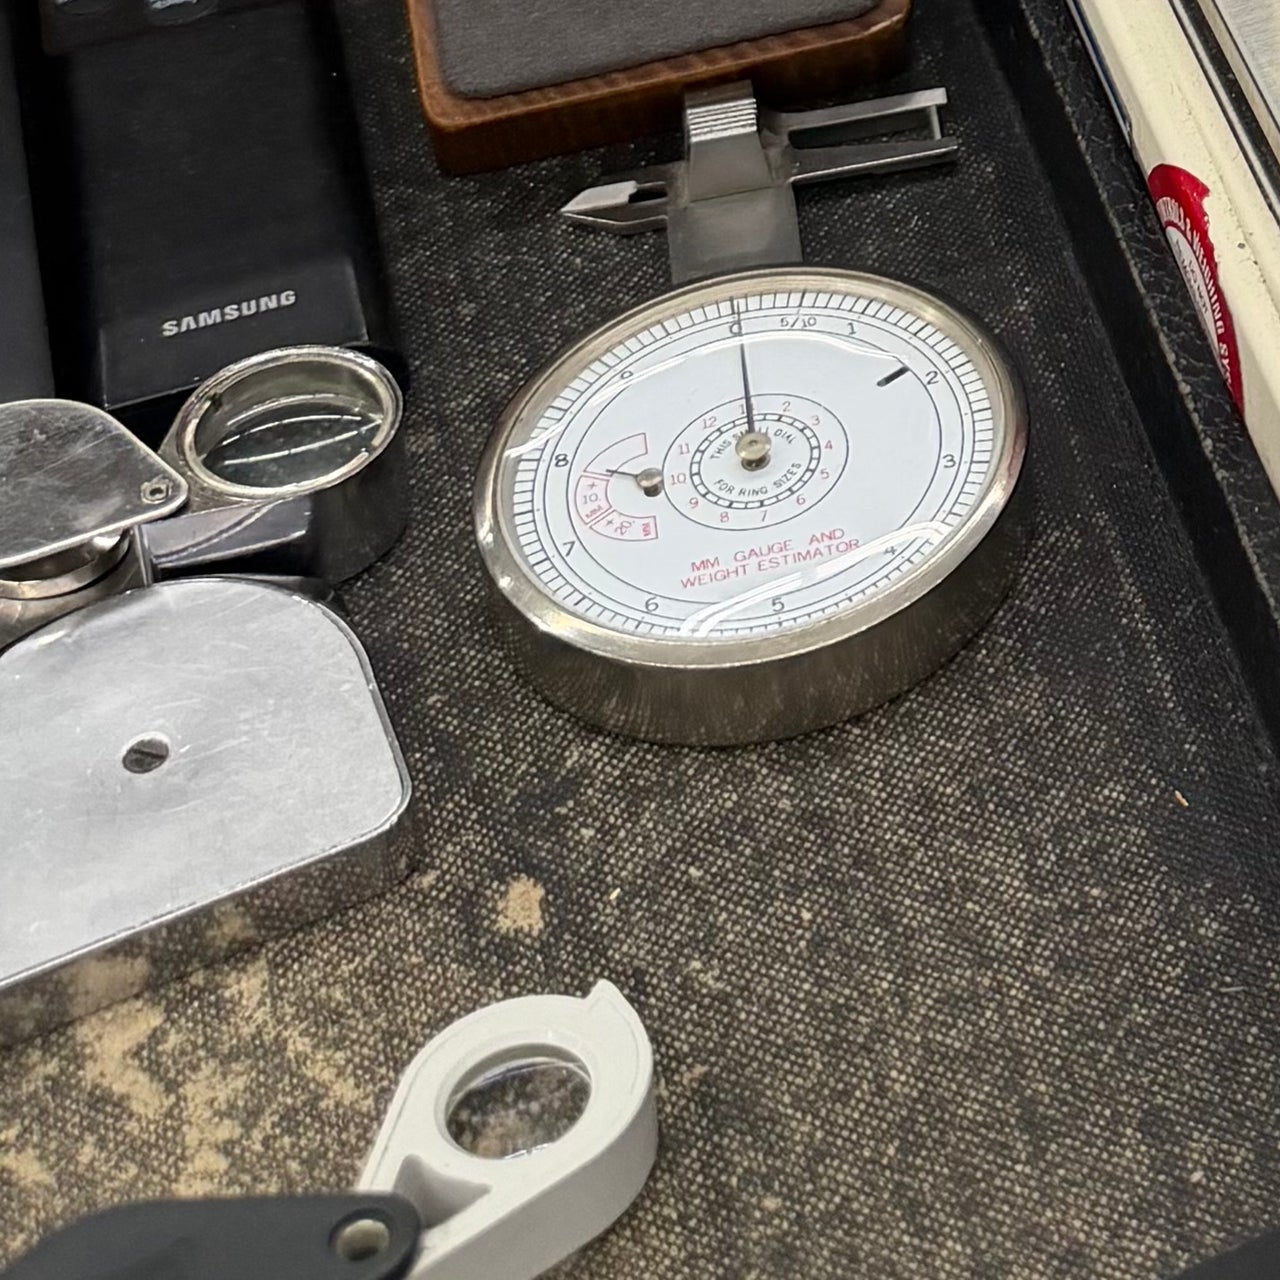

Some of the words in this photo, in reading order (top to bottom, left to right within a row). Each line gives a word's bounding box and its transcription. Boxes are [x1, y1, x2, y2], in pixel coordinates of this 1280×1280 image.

[161, 290, 297, 337] SAMSUNG
[780, 315, 817, 329] 5/10
[846, 321, 857, 336] 1
[925, 369, 940, 386] 2
[782, 400, 791, 413] 2
[702, 416, 717, 429] 12
[811, 414, 820, 426] 3
[679, 443, 690, 455] 11
[824, 440, 833, 450] 4
[554, 453, 569, 467] 8
[941, 453, 957, 468] 3
[670, 472, 687, 486] 10
[713, 479, 735, 495] FOR
[738, 486, 768, 496] RING
[773, 462, 802, 489] SIZES
[820, 468, 830, 480] 5
[689, 497, 699, 509] 9
[796, 493, 806, 506] 6
[720, 511, 729, 523] 8
[760, 510, 768, 522] 7
[562, 540, 576, 557] 7
[691, 556, 720, 573] MM
[733, 539, 793, 563] GAUGE
[808, 528, 845, 546] AND
[883, 545, 898, 557] 4
[681, 563, 749, 589] WEIGHT
[757, 538, 860, 572] ESTIMATOR
[644, 596, 659, 612] 6
[771, 597, 785, 612] 5
